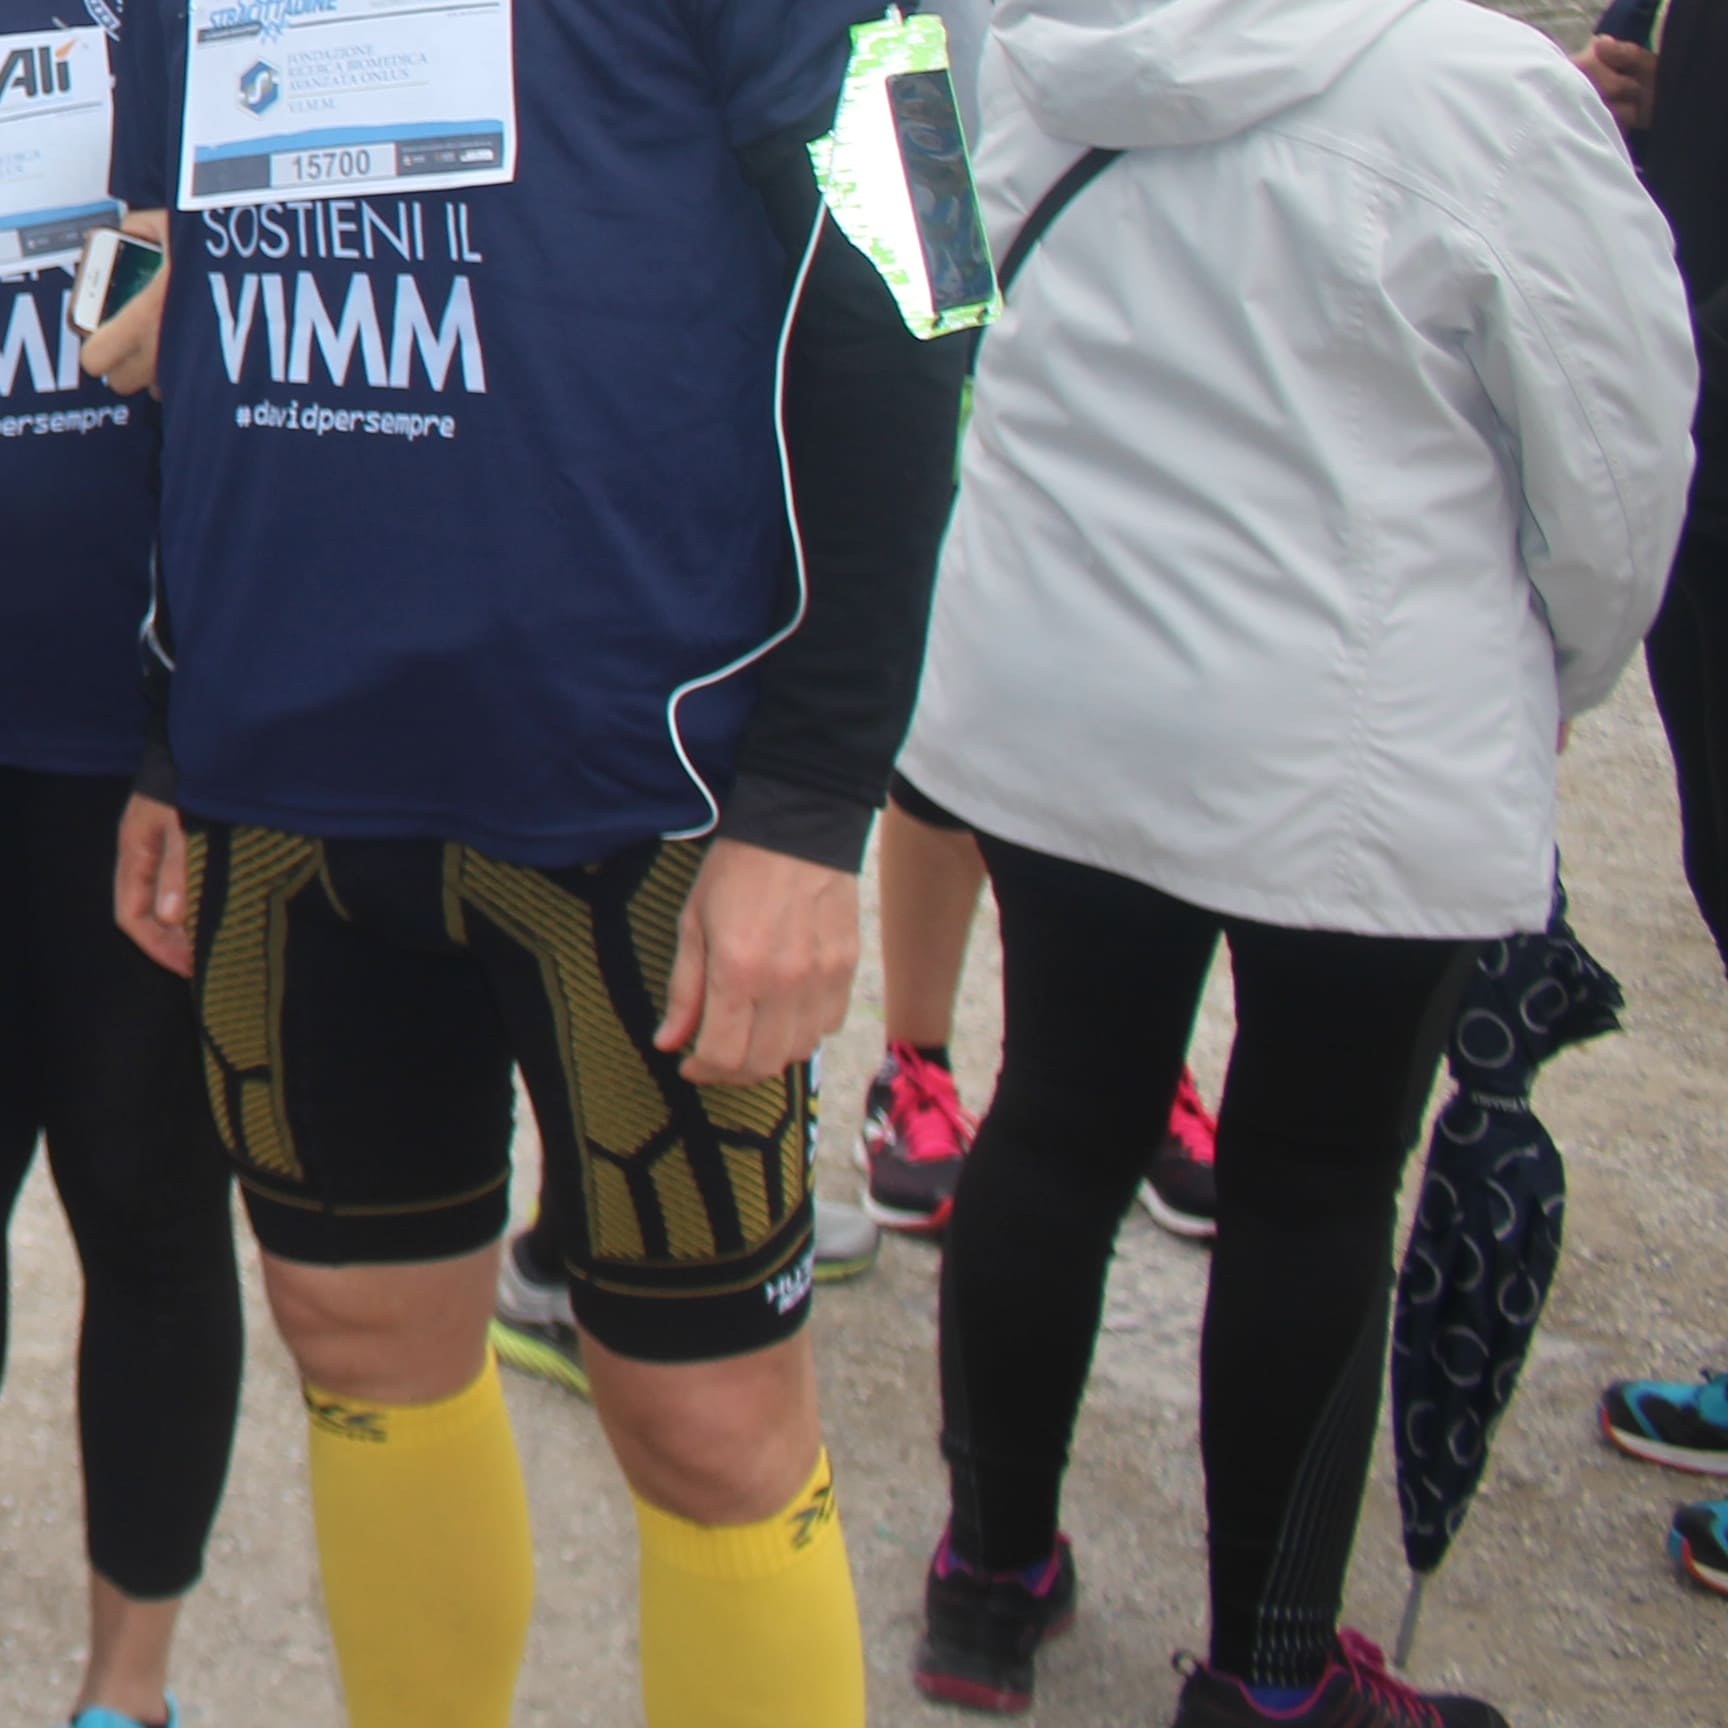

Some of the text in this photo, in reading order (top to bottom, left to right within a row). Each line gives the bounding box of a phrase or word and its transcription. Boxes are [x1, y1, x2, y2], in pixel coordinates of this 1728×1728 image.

[293, 149, 371, 181] 15700
[202, 201, 483, 263] SOSTIENI IL
[208, 270, 486, 393] VIMM
[236, 399, 455, 442] #davidpersempre
